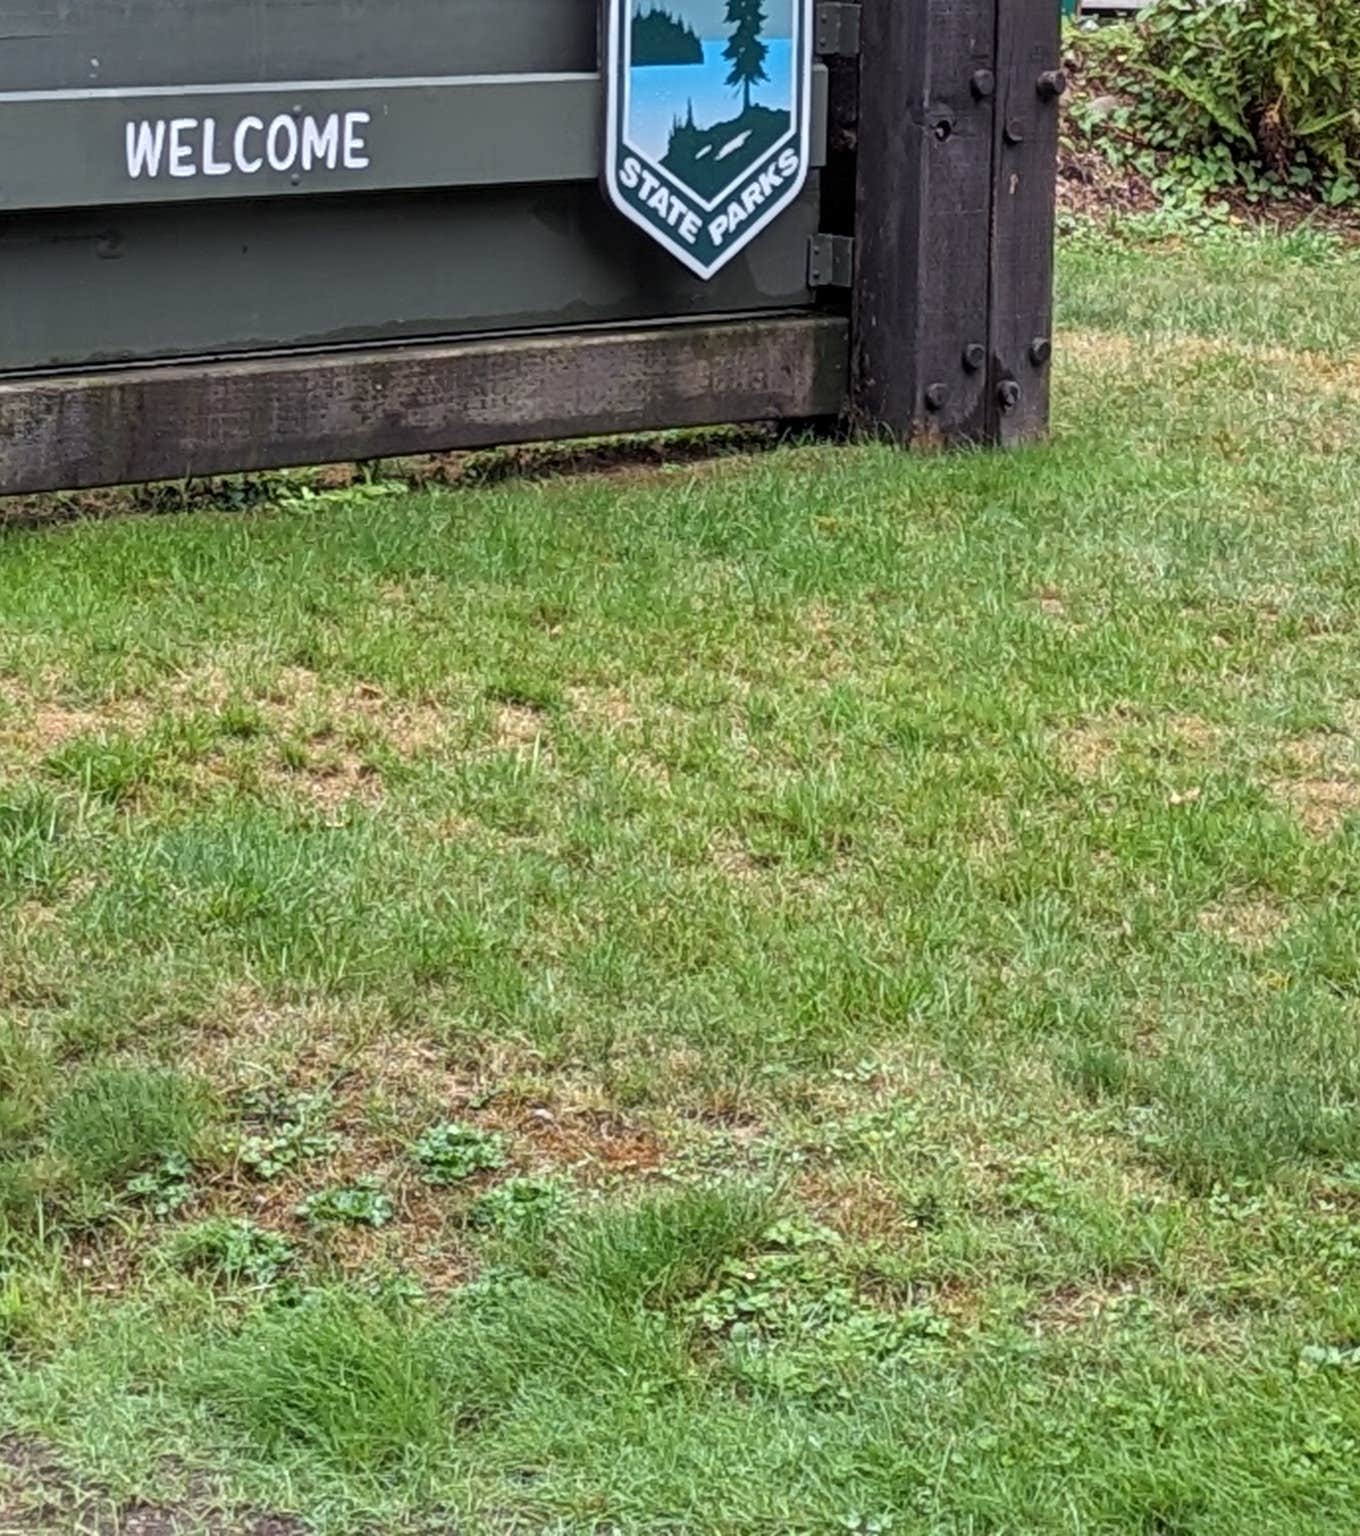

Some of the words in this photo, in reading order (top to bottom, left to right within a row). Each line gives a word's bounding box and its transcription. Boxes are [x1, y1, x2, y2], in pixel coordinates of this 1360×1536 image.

[125, 112, 371, 178] WELCOME
[619, 156, 703, 244] STATE
[707, 147, 800, 248] PARKS
